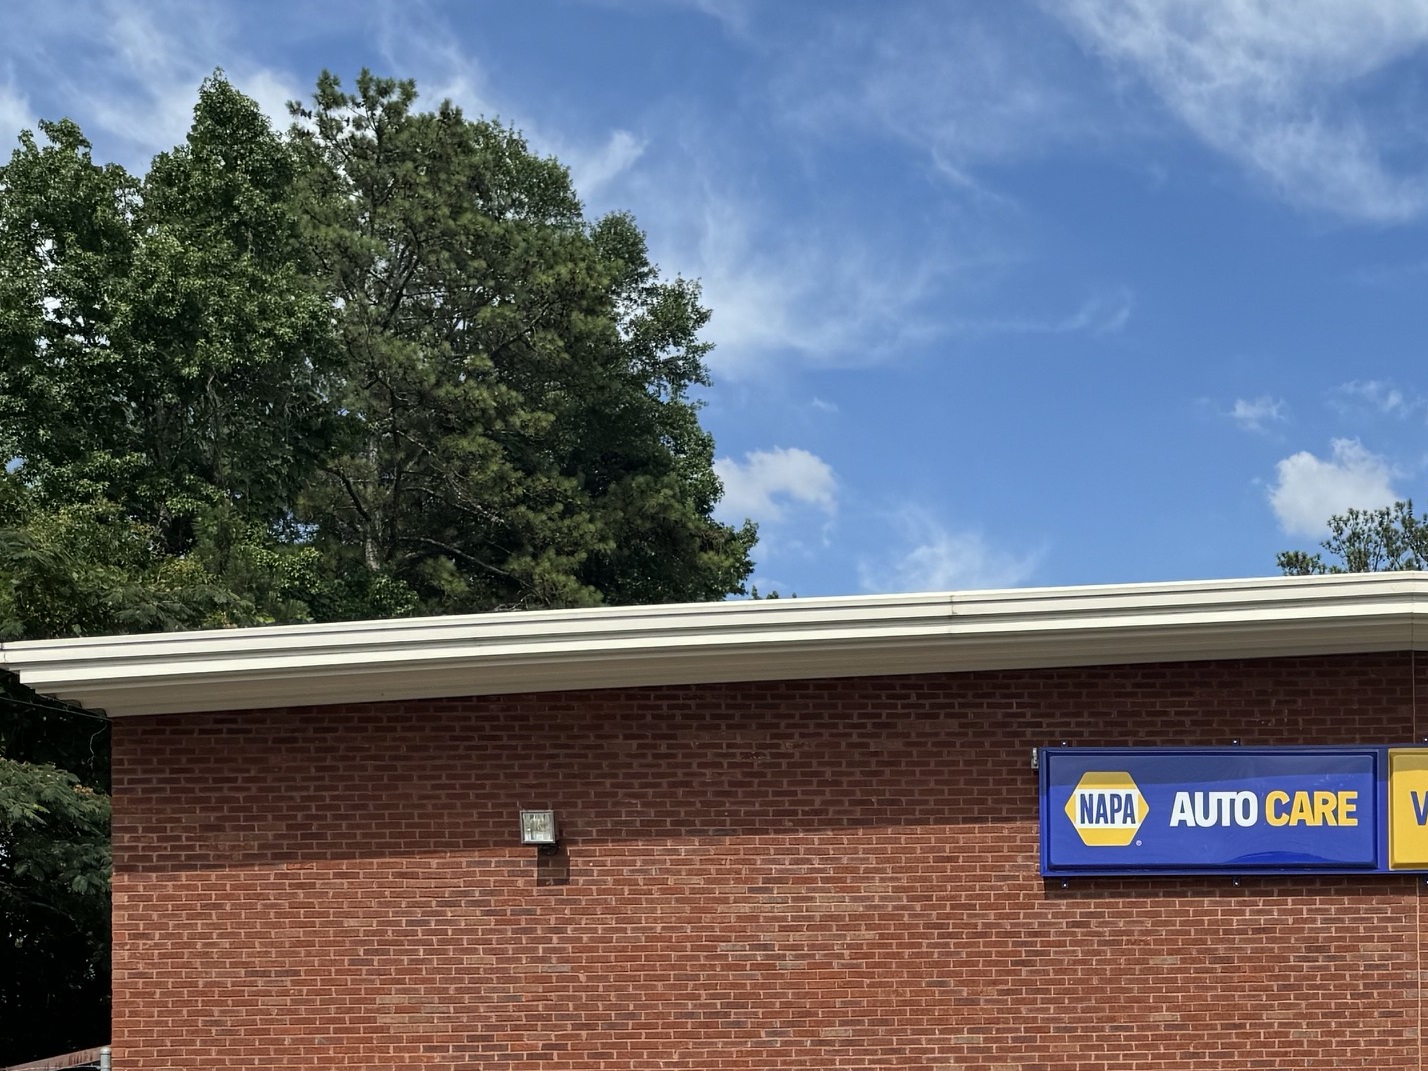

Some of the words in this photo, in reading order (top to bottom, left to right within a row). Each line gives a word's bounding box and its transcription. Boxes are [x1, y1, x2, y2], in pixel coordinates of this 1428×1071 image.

[1079, 793, 1137, 825] NAPA
[1169, 791, 1258, 827] AUTO
[1265, 790, 1359, 827] CARE
